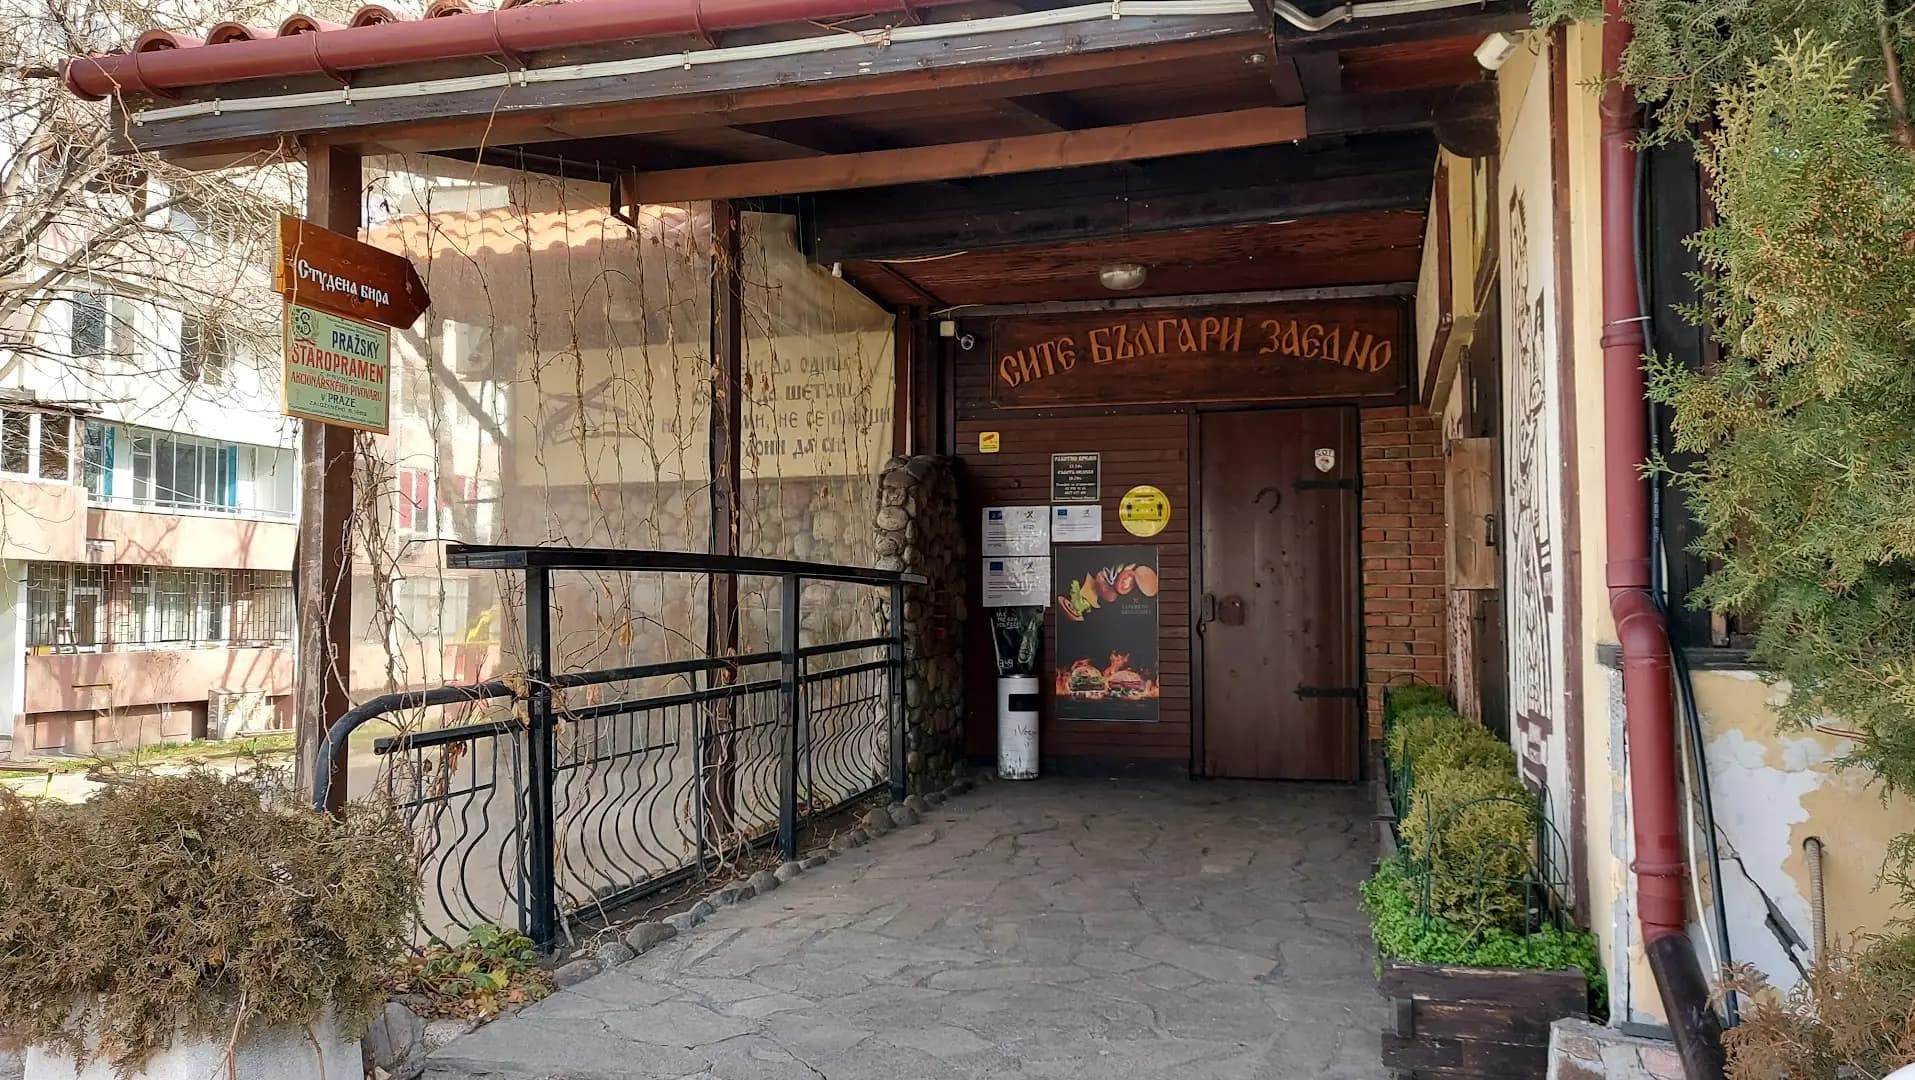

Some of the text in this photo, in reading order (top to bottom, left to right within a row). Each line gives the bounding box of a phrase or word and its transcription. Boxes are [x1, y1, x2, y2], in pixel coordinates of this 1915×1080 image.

[331, 330, 380, 360] PRAŽSKÝ
[1000, 316, 1393, 388] СИТЕ БЪЛГАРИ ЗАЕДНО
[328, 393, 357, 408] PRAZE
